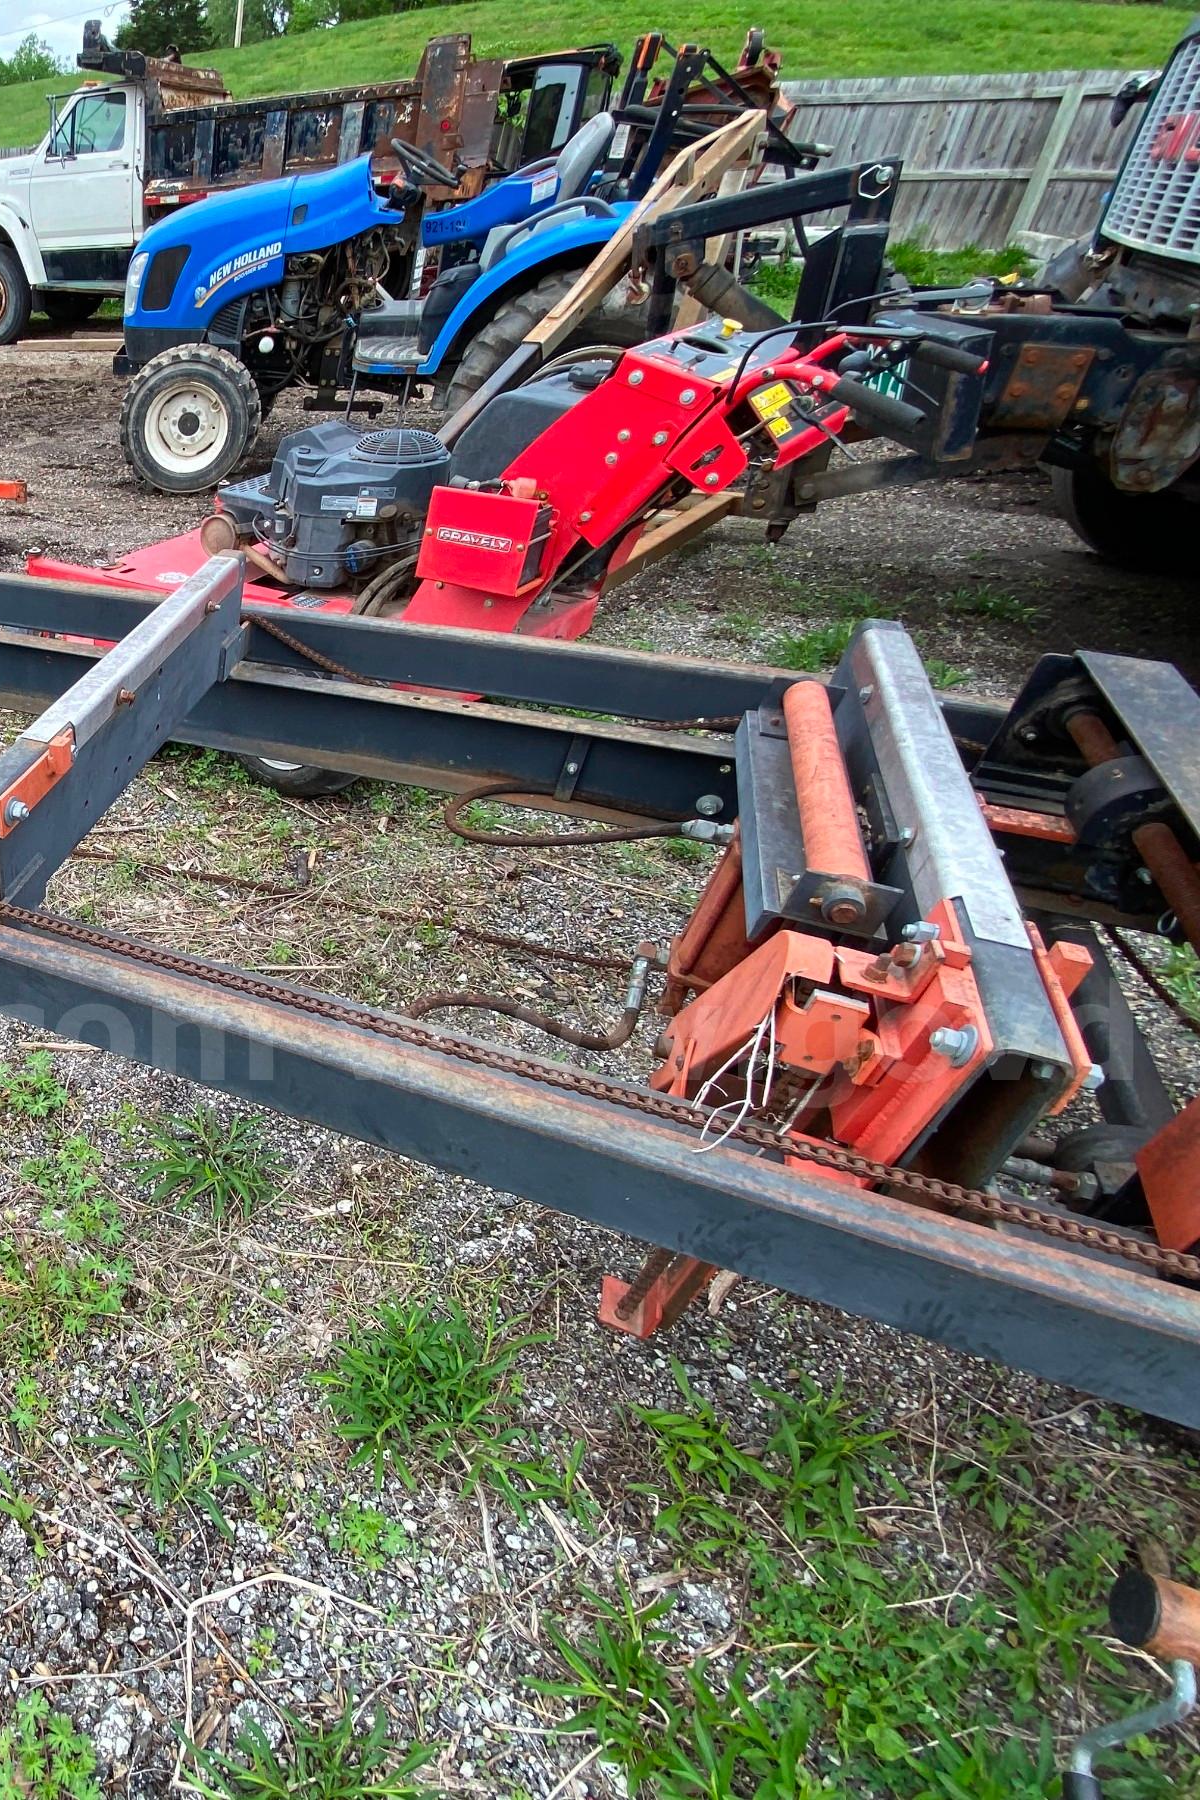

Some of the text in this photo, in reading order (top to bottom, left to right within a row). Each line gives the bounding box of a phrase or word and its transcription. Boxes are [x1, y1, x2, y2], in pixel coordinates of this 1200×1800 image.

[209, 241, 282, 288] NEW HOLLAND
[440, 530, 509, 550] GRAVELY
